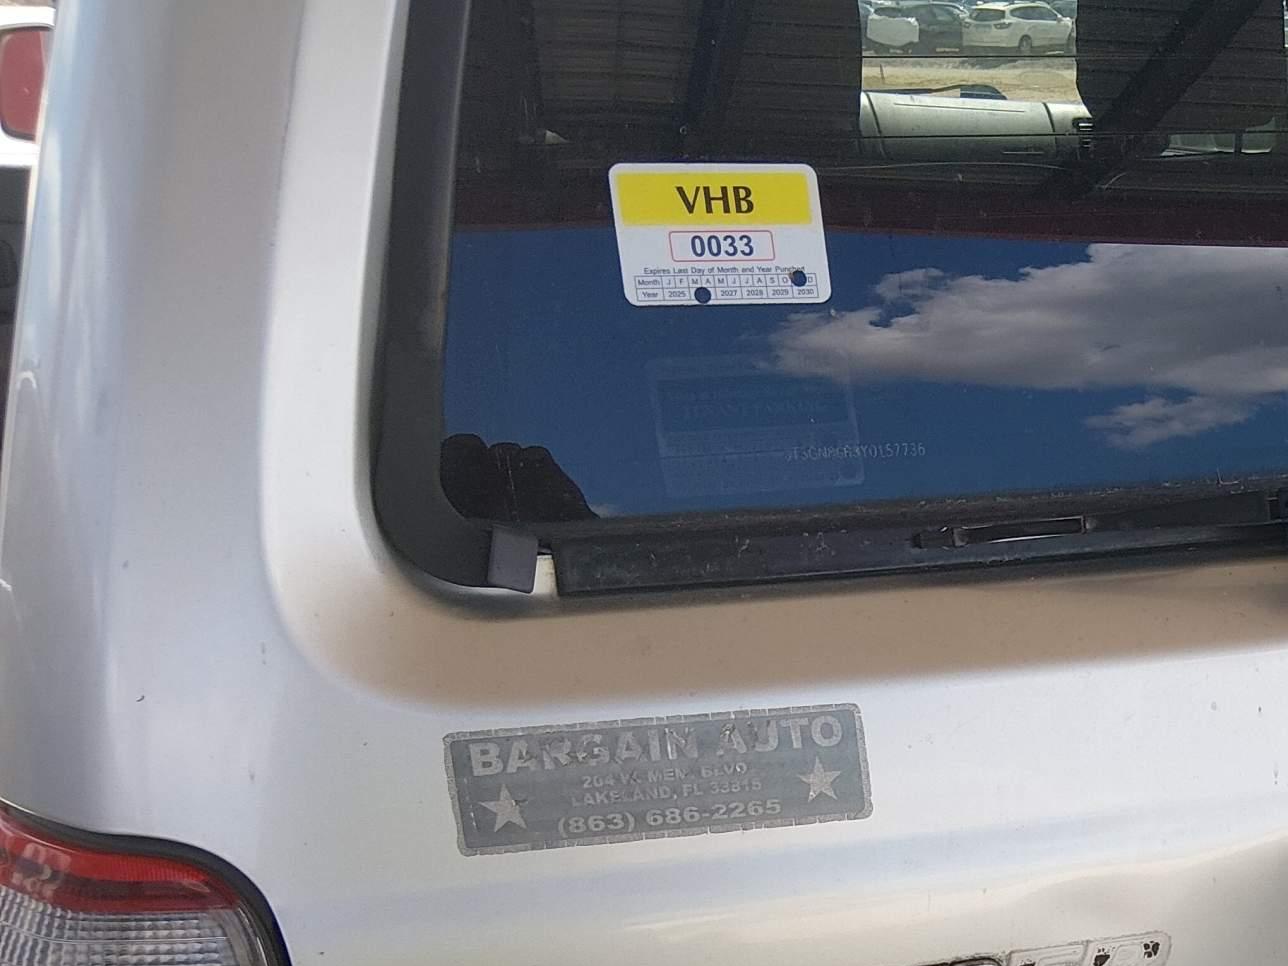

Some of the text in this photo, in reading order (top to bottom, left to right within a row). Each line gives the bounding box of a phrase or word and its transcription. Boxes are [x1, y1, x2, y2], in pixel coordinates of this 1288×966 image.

[675, 186, 754, 214] VHB
[691, 235, 754, 257] 0033
[643, 267, 671, 276] Expires
[691, 267, 705, 276] Day
[757, 276, 763, 284] A
[668, 290, 686, 298] 2025
[720, 289, 738, 297] 2027
[797, 288, 815, 296] 2030
[469, 714, 843, 777] BARGAIN AUTO
[571, 783, 678, 808] LAKELAND,
[682, 782, 704, 797] FL
[558, 799, 781, 838] (863) 686-2265
